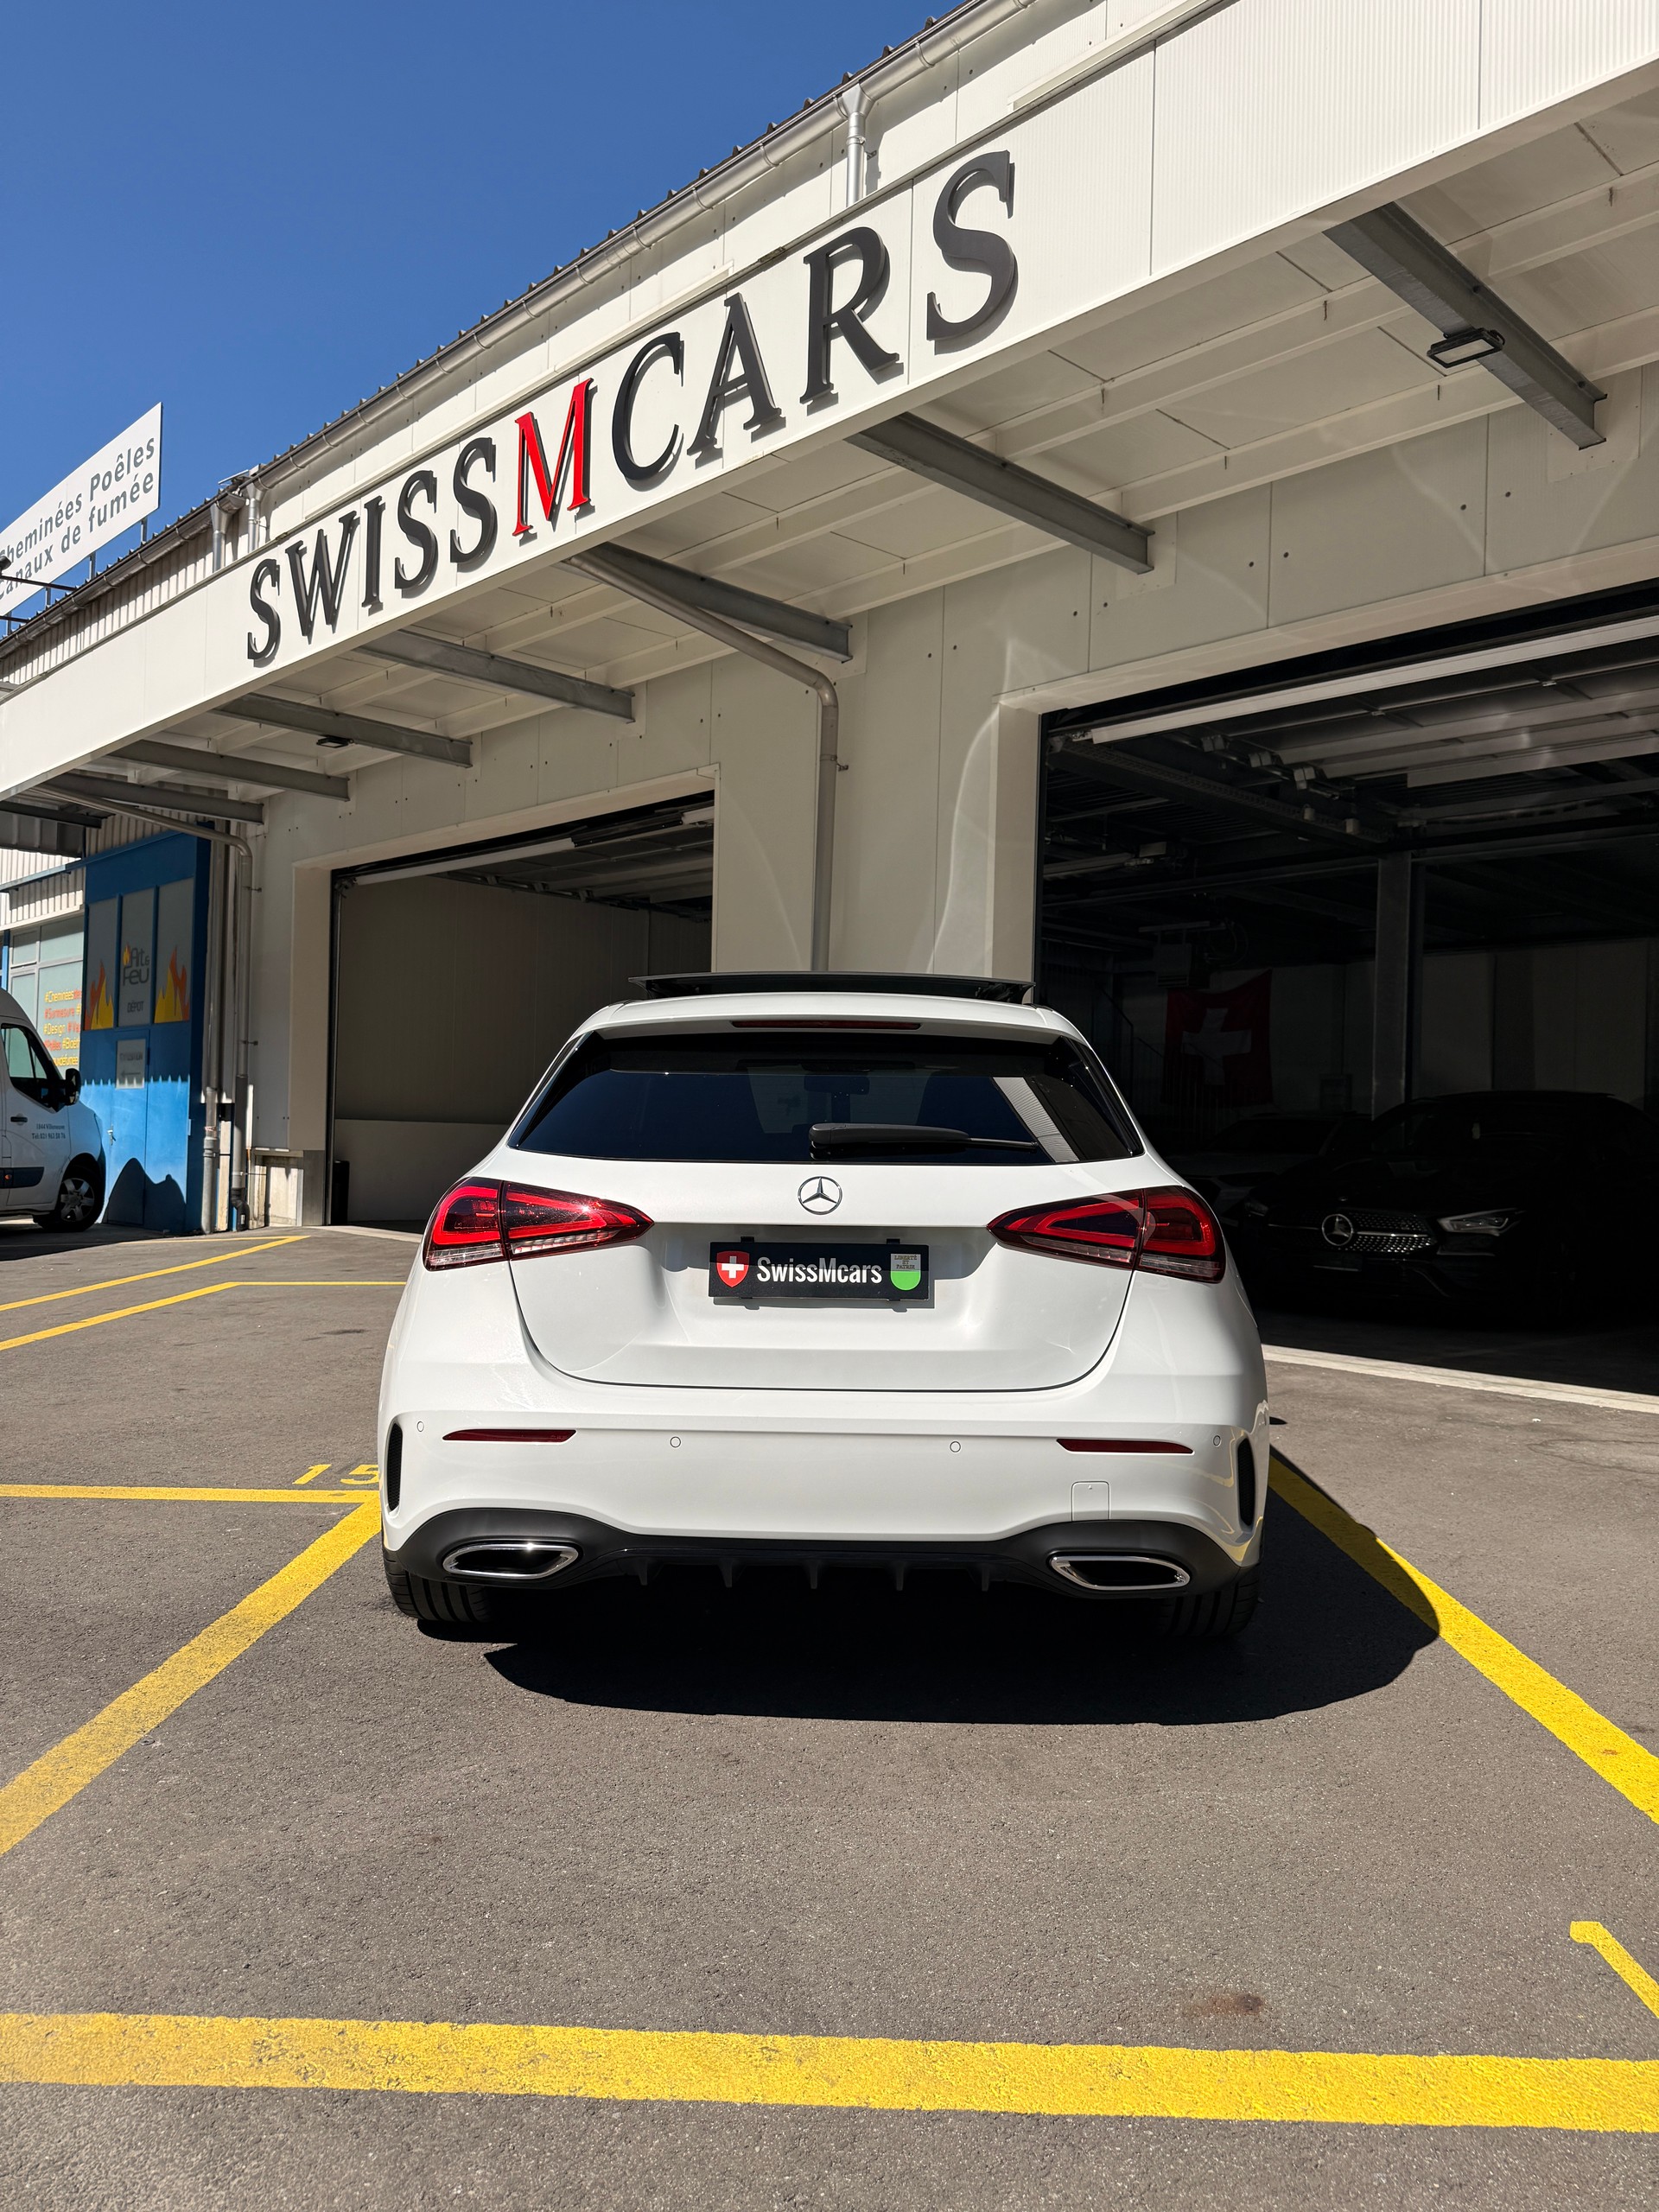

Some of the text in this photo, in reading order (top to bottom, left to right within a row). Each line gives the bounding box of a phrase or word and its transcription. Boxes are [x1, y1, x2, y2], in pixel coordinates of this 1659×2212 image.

[89, 437, 155, 502] Poêles
[61, 525, 81, 553] de
[88, 472, 154, 533] fumée
[757, 1256, 882, 1283] SwissMcars
[292, 1464, 378, 1484] 15
